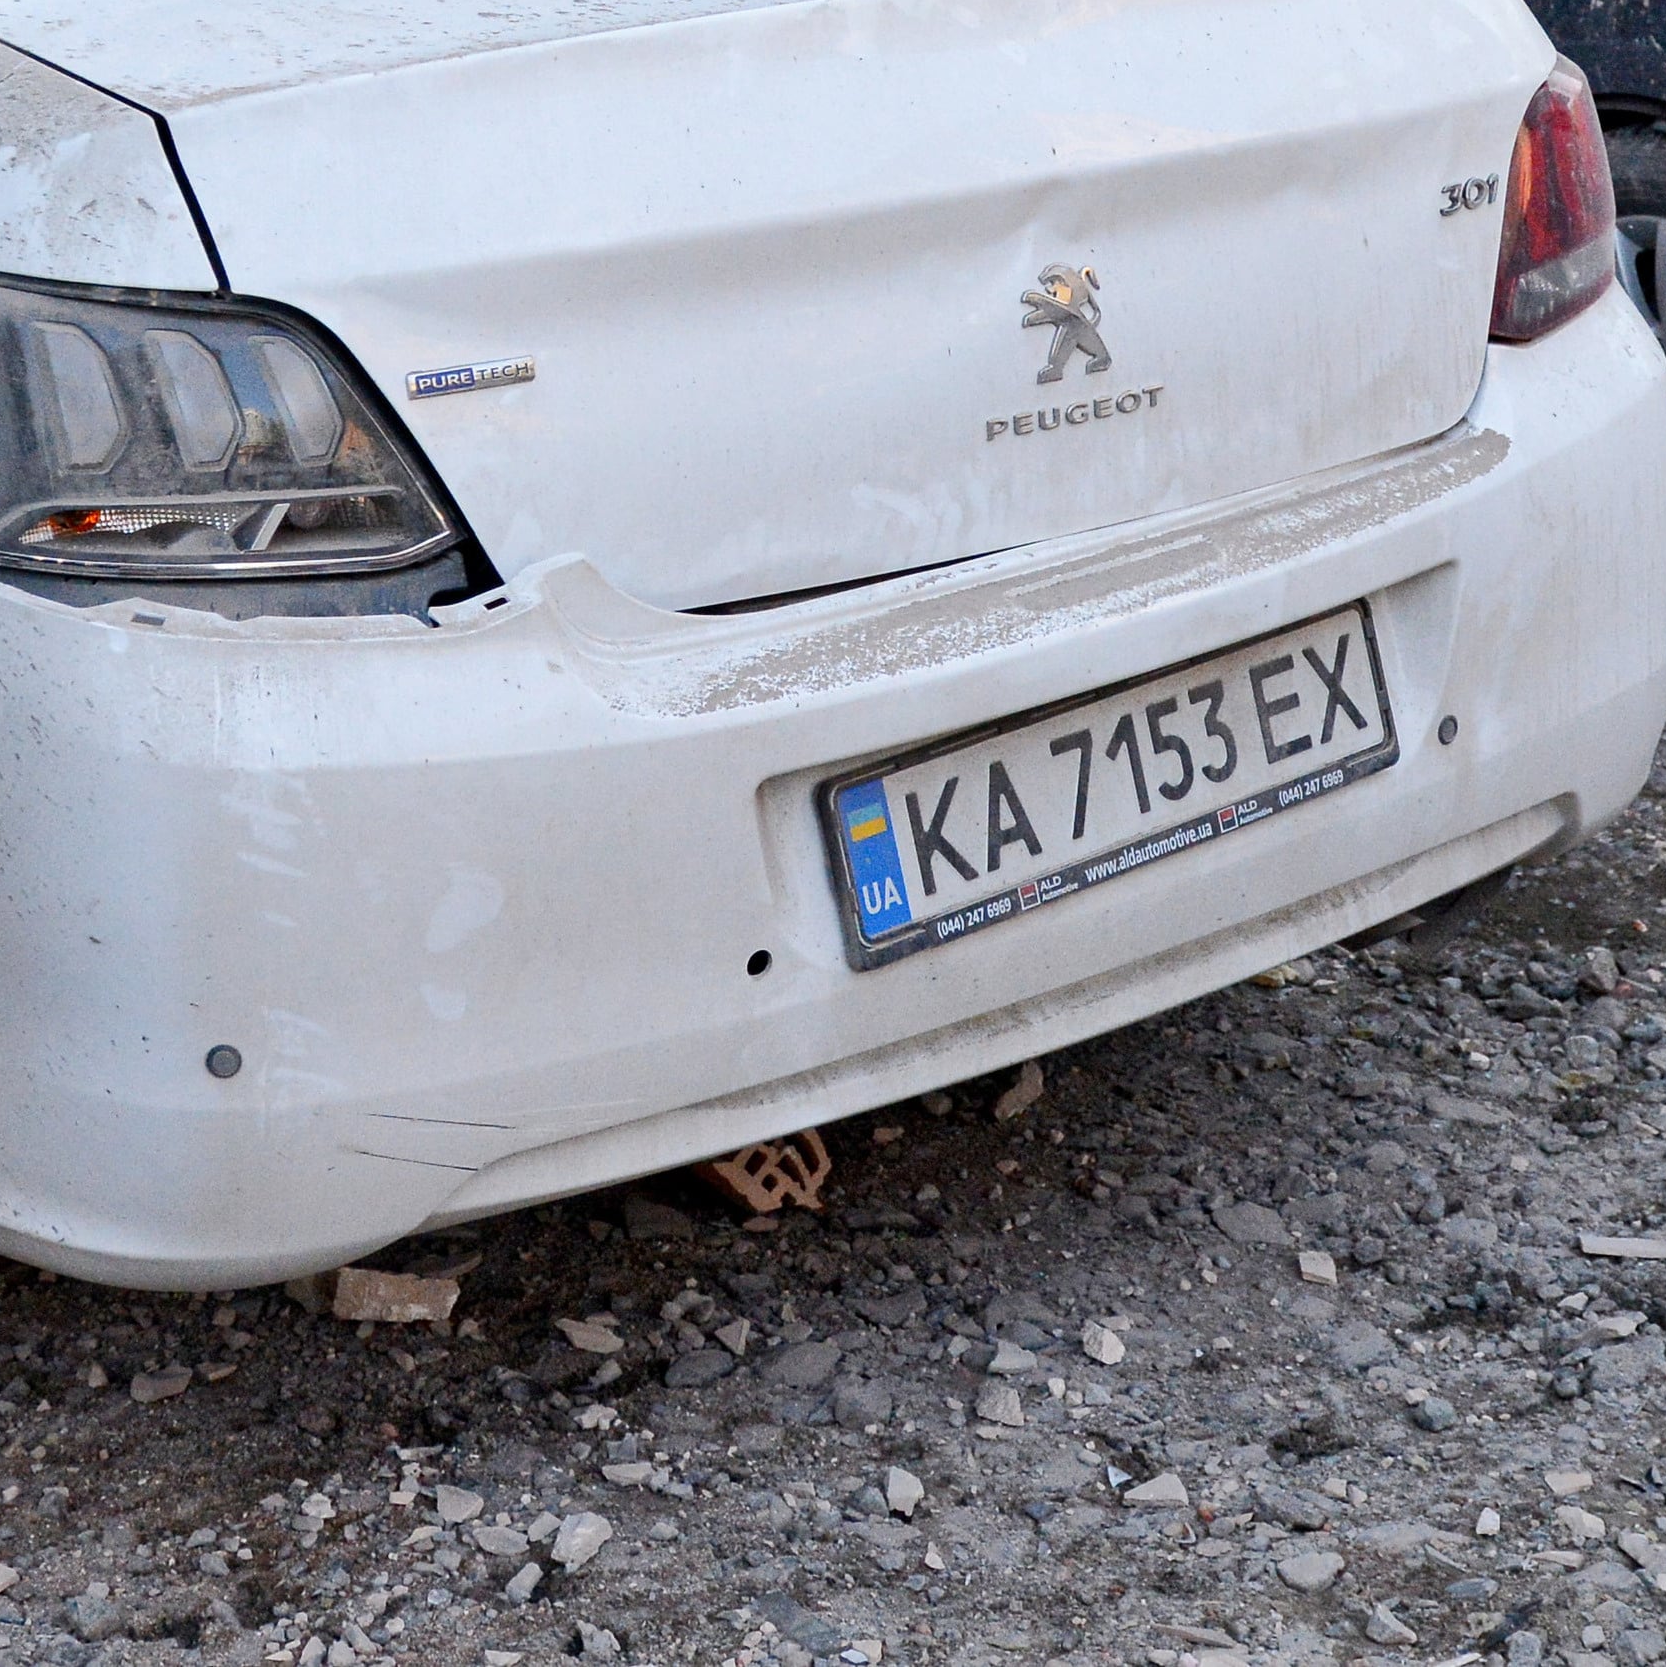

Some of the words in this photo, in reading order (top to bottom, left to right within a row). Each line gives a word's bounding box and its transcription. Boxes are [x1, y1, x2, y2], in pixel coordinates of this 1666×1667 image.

[1439, 173, 1500, 216] 301
[985, 384, 1165, 442] PEUGEOT
[905, 760, 1042, 896] KA
[1049, 679, 1237, 839] 7153
[1248, 633, 1369, 764] EX
[1237, 799, 1258, 816] ALD
[1278, 783, 1303, 808] (044)
[1303, 778, 1321, 797] 247
[1322, 769, 1344, 790] 6969
[1239, 806, 1274, 826] Automotive
[1084, 821, 1213, 883] www.aldautomotive.ua
[862, 876, 903, 915] UA
[1040, 876, 1062, 893] ALD
[1041, 882, 1079, 902] Automotive
[937, 917, 965, 939] (044)
[966, 908, 985, 927] 247
[986, 897, 1012, 920] 6969
